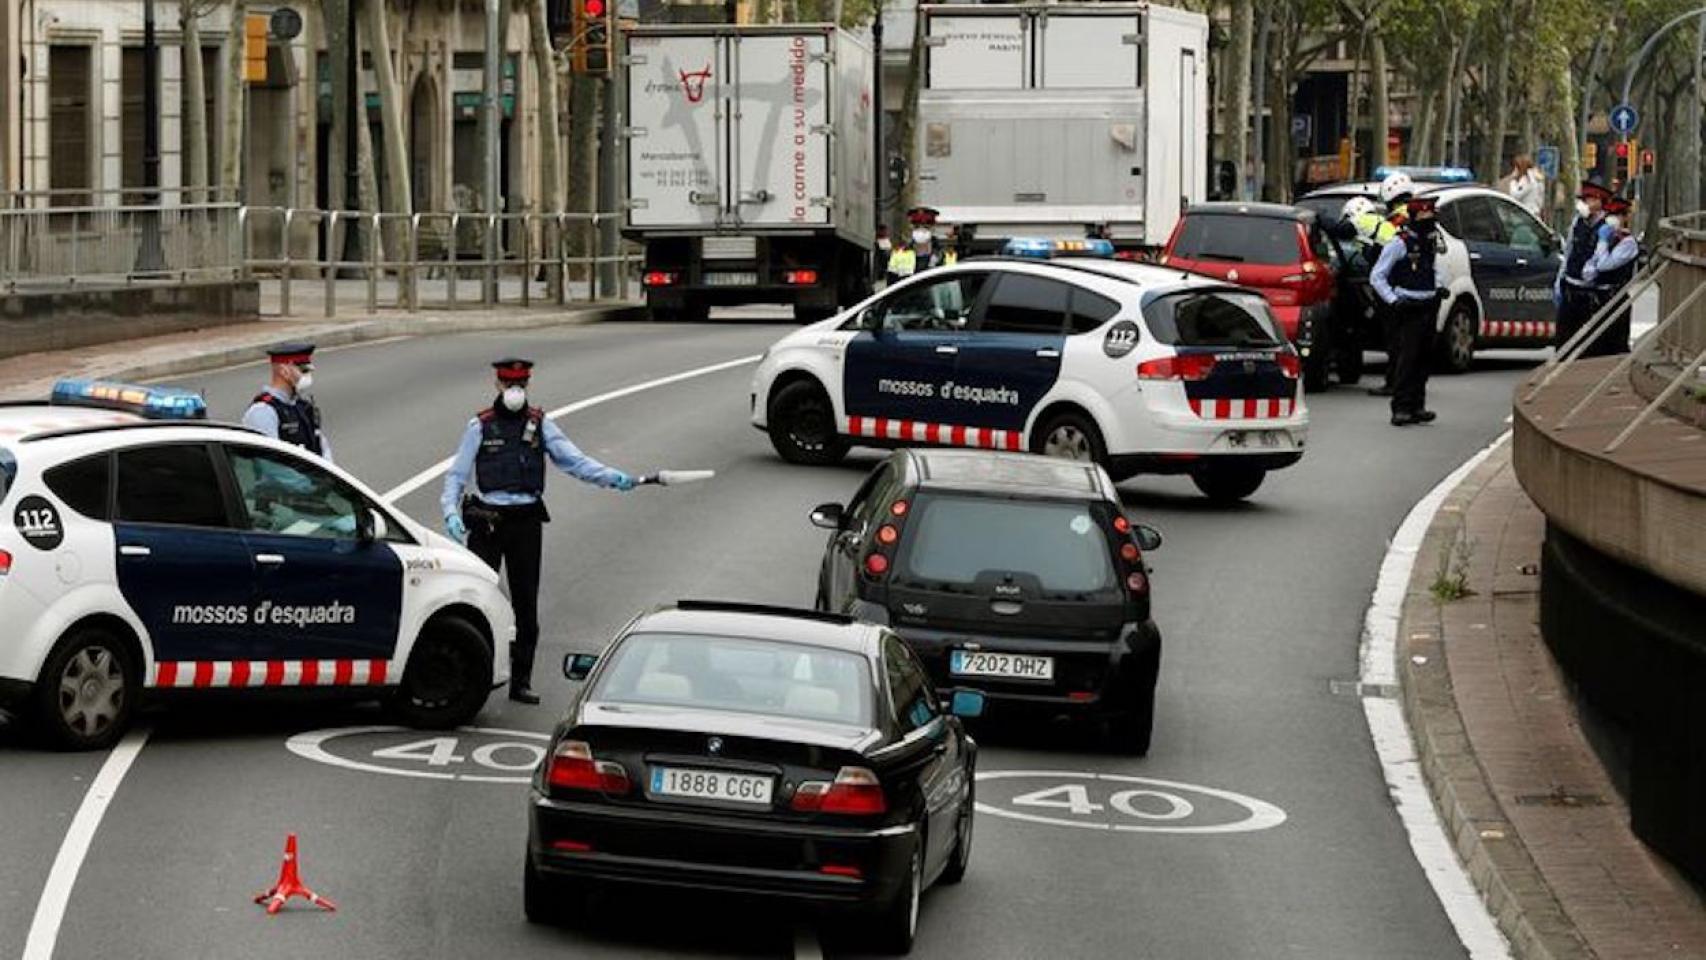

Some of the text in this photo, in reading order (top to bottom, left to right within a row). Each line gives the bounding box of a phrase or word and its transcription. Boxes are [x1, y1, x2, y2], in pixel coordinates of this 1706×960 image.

[794, 109, 805, 128] su
[794, 134, 805, 146] a
[794, 151, 805, 200] carne
[1109, 329, 1136, 345] 112
[878, 378, 1019, 405] mossos d'esquadra
[19, 508, 55, 530] 112
[172, 600, 356, 629] mossos d'esquadra
[964, 653, 1047, 676] 7202 DHZ
[372, 736, 548, 770] 40
[670, 770, 764, 798] 1888 CGC
[1012, 784, 1194, 819] 40
